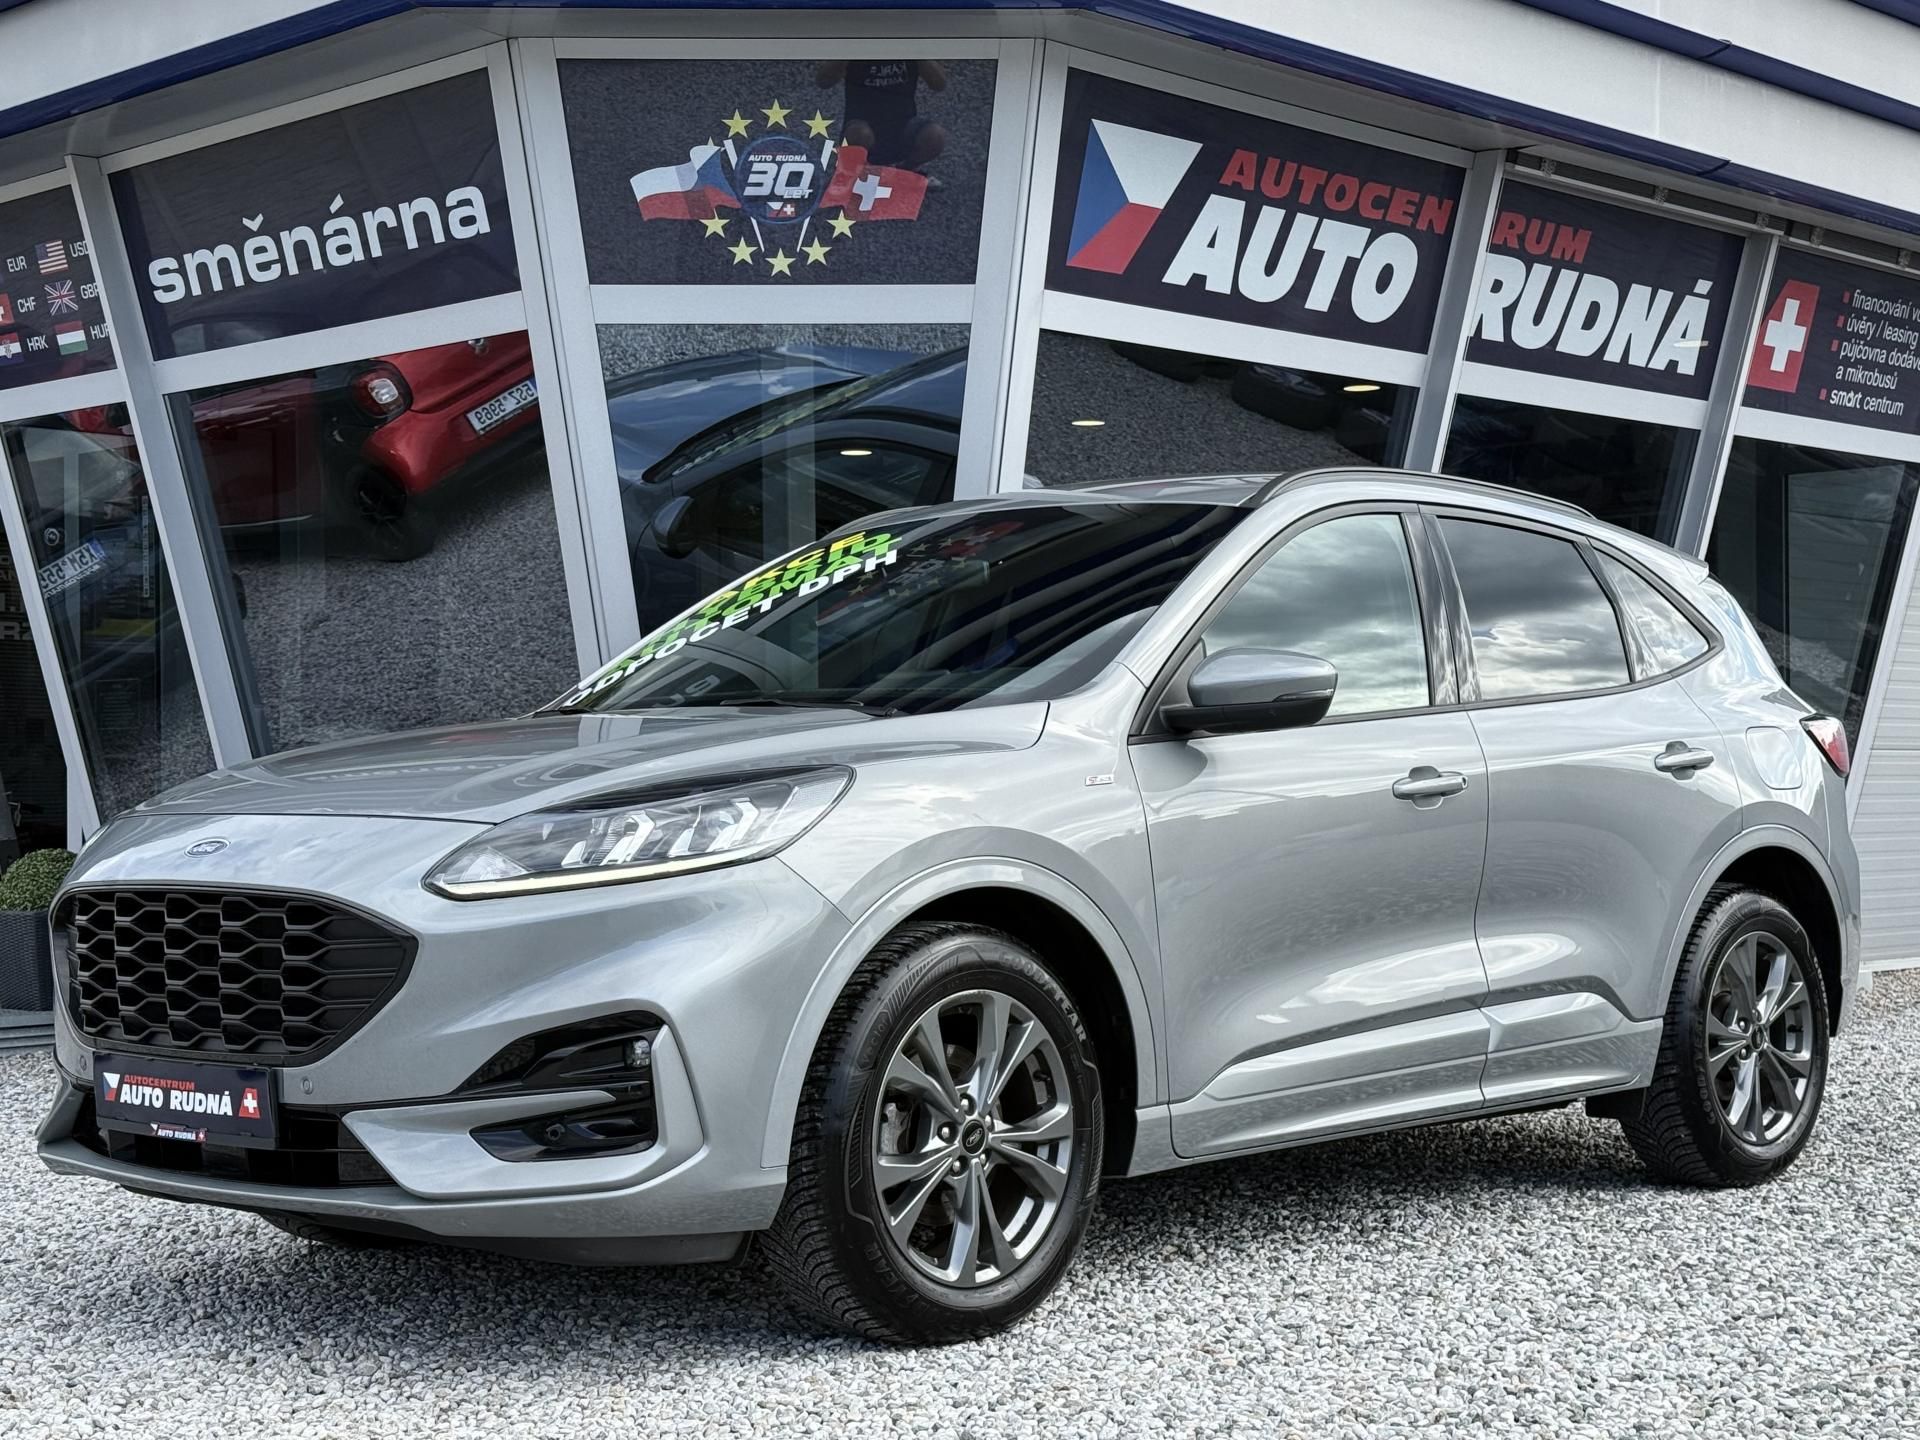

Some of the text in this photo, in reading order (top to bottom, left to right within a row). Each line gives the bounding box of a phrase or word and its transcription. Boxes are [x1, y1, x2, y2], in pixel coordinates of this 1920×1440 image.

[743, 162, 815, 196] 30
[148, 186, 491, 303] směnárna
[6, 255, 27, 272] EUR
[1161, 193, 1713, 376] AUTO RUDNÁ
[17, 296, 37, 313] CHF
[1852, 289, 1912, 319] financování
[27, 335, 48, 352] HRK
[1847, 313, 1876, 340] úvěry
[1883, 320, 1919, 350] leasing
[1840, 338, 1887, 363] půjčovna
[1836, 364, 1898, 390] a mikrobusů
[1863, 394, 1904, 416] centrum
[700, 531, 867, 613] AKCE
[798, 548, 898, 598] DPH
[124, 1074, 195, 1091] AUTOCENTRUM
[119, 1083, 233, 1116] AUTO RUDNÁ
